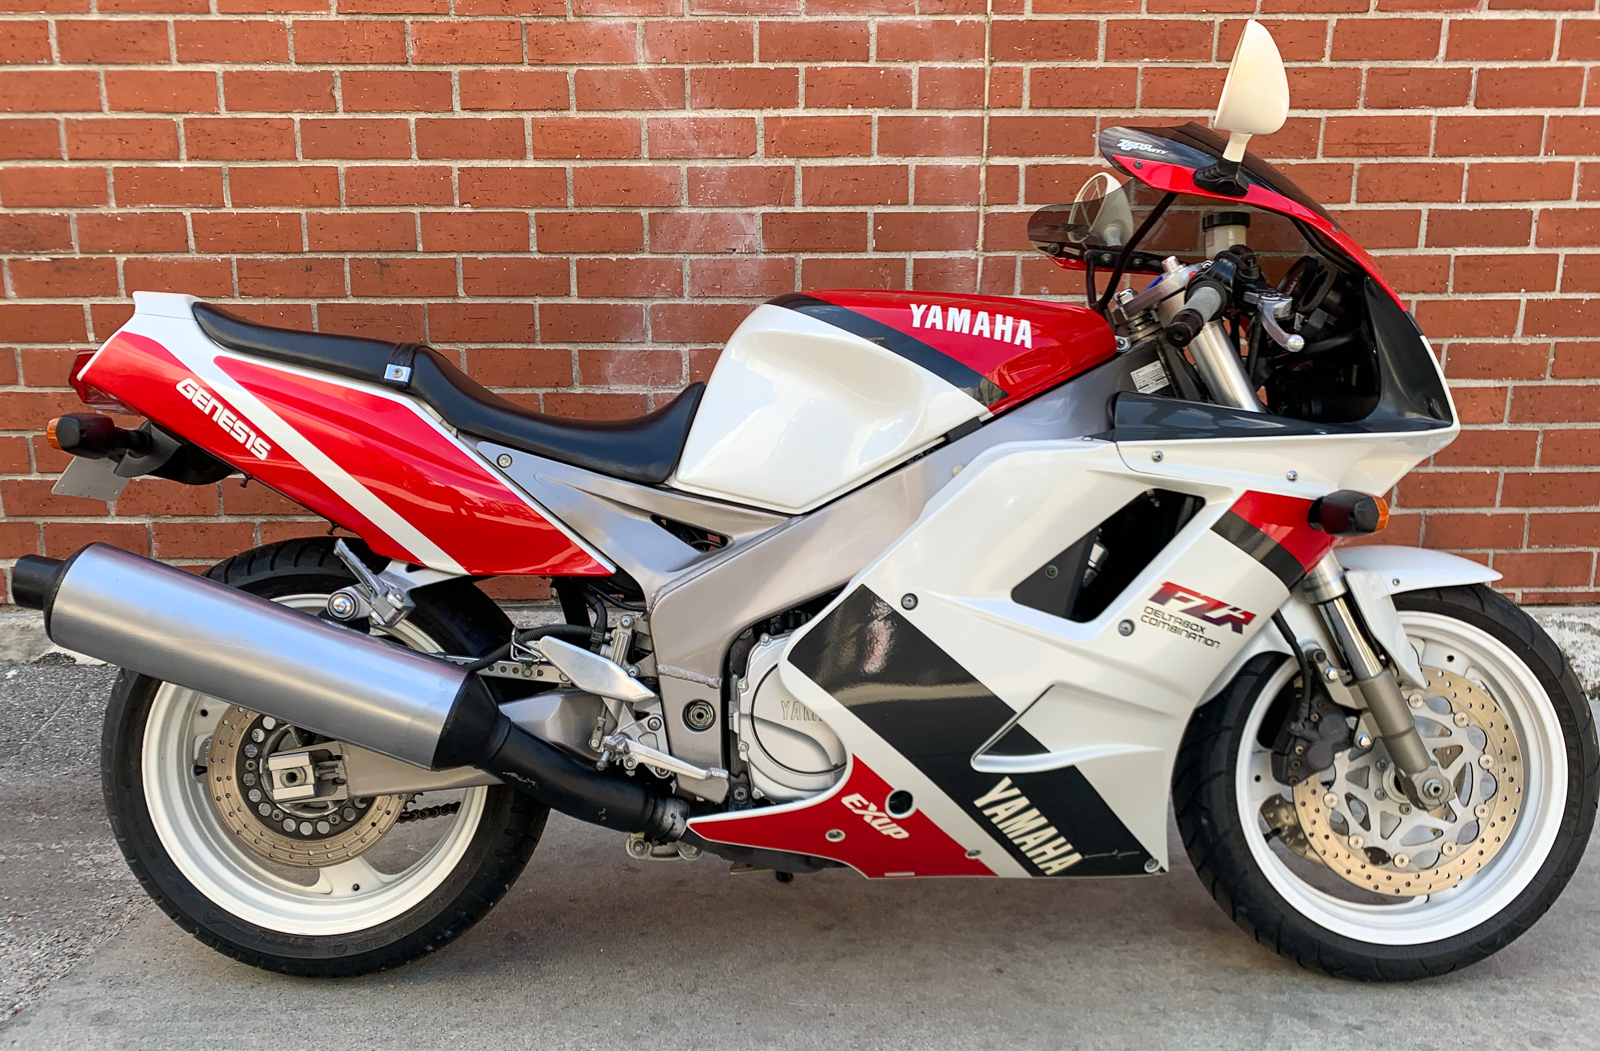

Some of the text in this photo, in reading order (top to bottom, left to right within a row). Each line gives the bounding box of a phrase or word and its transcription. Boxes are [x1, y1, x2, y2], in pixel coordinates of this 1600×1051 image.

[909, 303, 1033, 349] YAMAHA
[175, 377, 272, 461] GENESIS
[1143, 605, 1206, 634] DELTABOX
[1148, 581, 1257, 635] FZR
[1140, 614, 1221, 649] COMBINATION
[780, 700, 822, 722] YAM
[841, 792, 910, 839] EXUP
[973, 776, 1084, 876] YAMAHA
